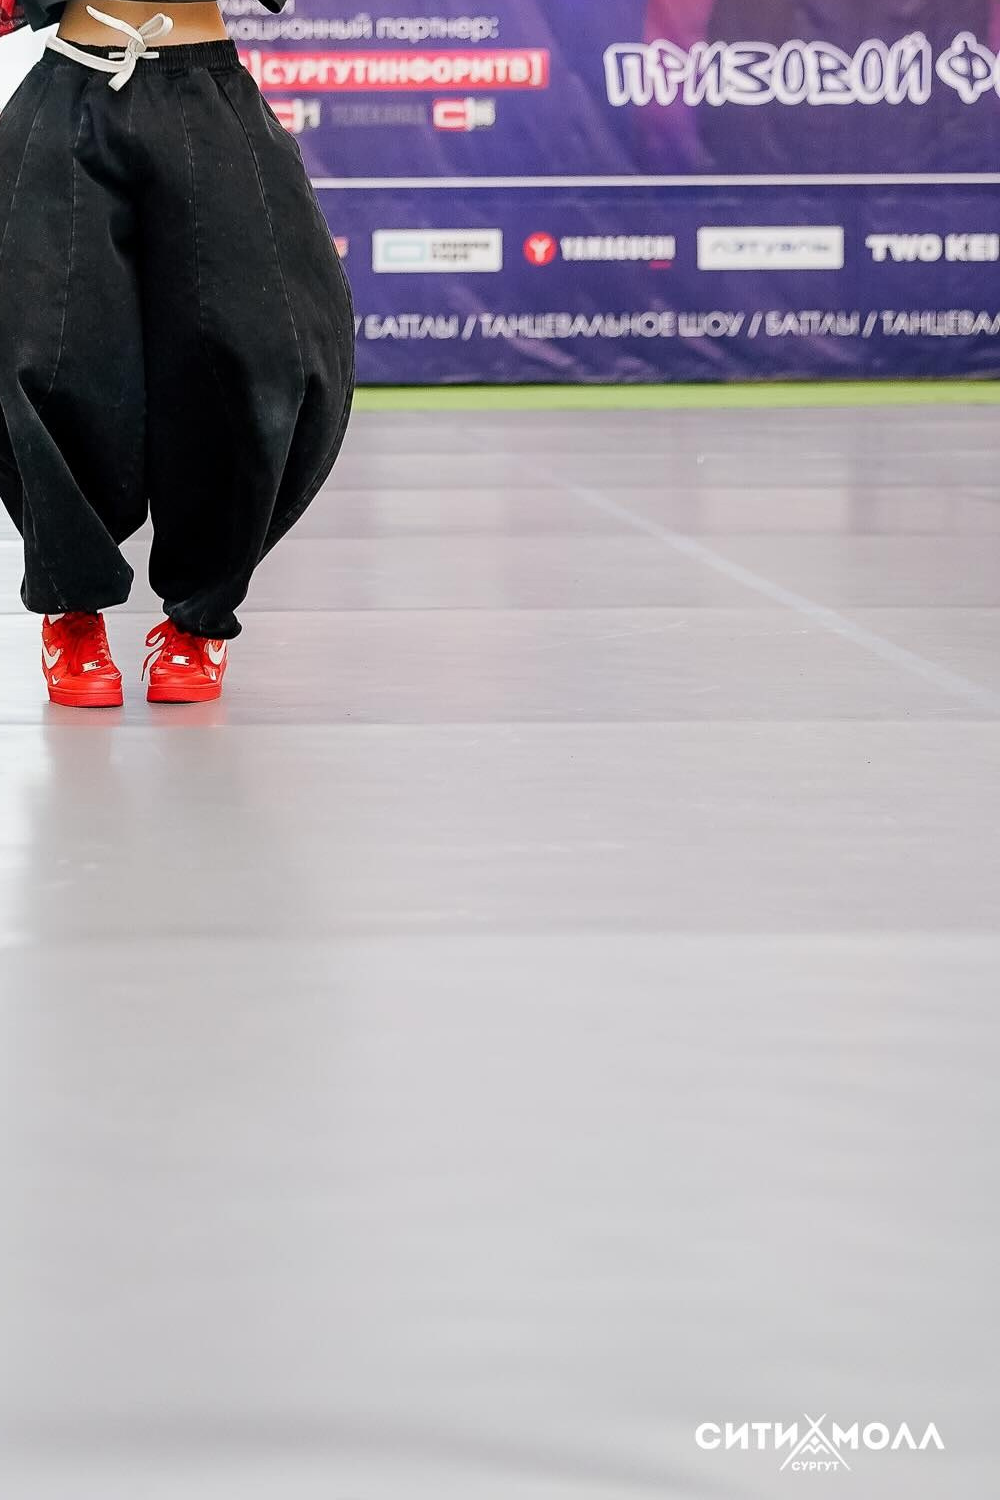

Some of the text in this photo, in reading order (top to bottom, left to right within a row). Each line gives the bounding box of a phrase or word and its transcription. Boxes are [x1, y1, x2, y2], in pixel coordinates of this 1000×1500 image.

[376, 15, 500, 44] партнер:
[603, 31, 1000, 107] ПРИЗОВОЙ Ф
[865, 233, 943, 262] TWO
[480, 311, 677, 339] ТАНЦЕВАЛЬНОЕ
[678, 311, 745, 338] ШОУ
